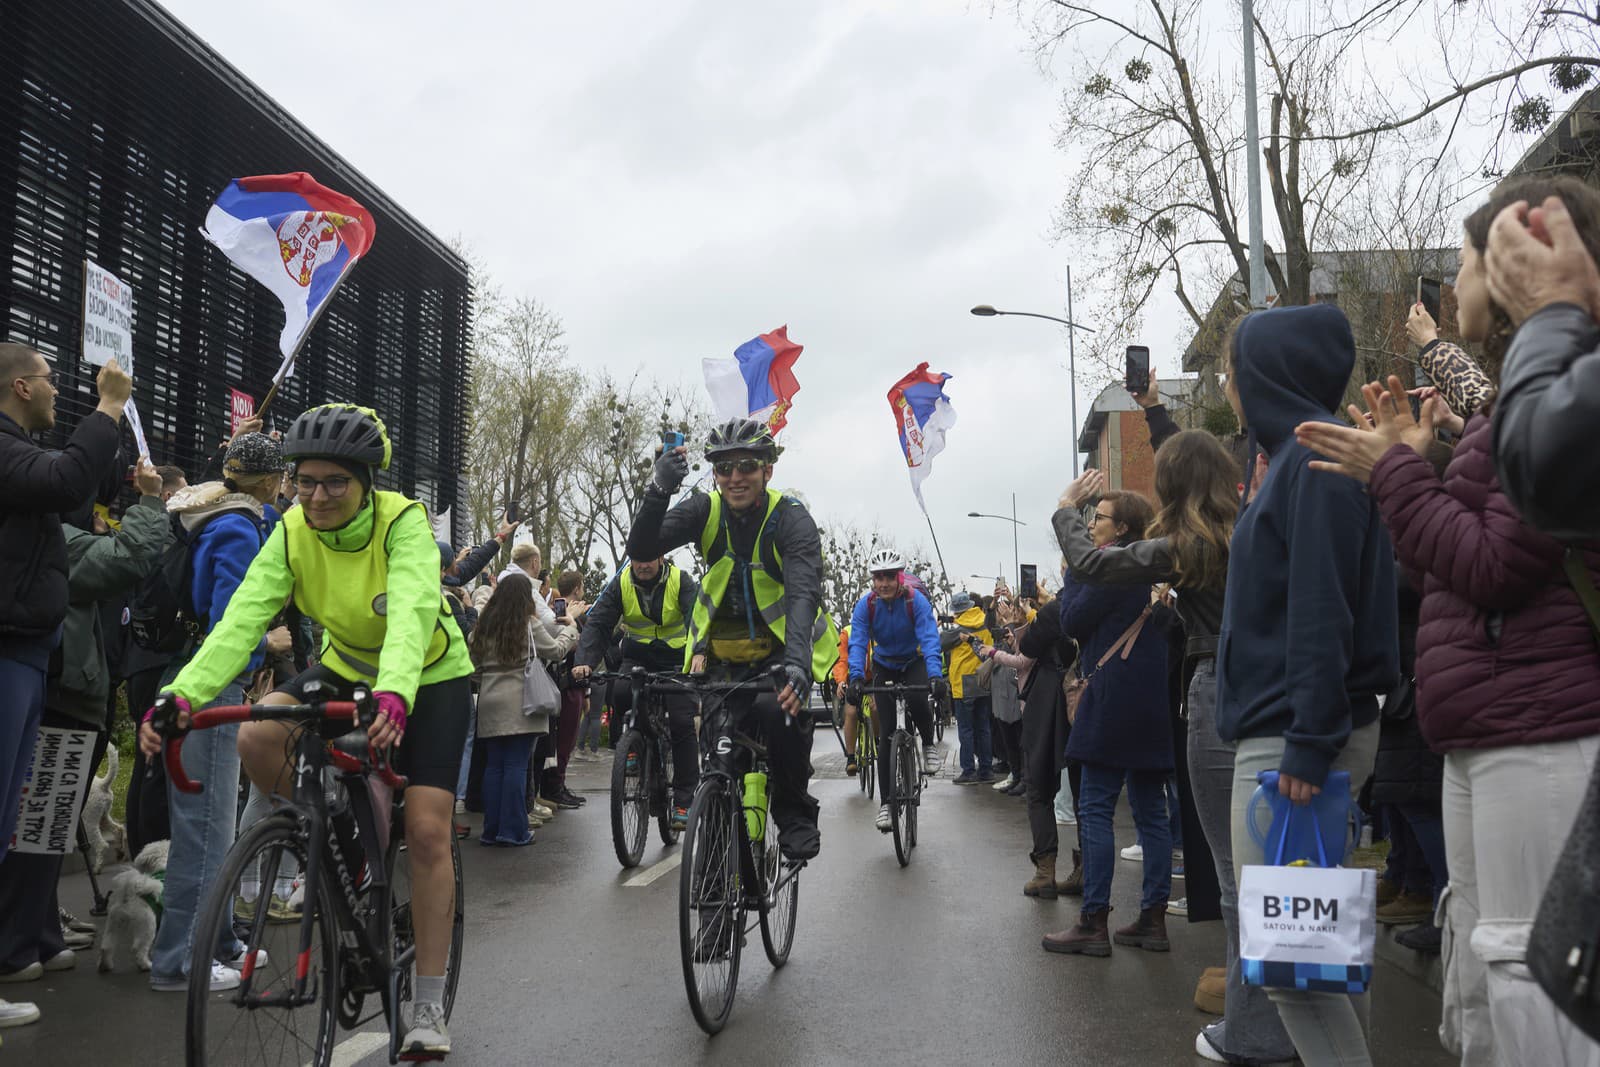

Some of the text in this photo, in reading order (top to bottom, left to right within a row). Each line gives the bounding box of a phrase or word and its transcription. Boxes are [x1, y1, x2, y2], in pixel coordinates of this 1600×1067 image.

[233, 396, 253, 417] NOVI
[68, 733, 86, 745] И
[40, 733, 63, 768] ИМАМО
[64, 751, 82, 770] МИ
[59, 772, 80, 786] СА
[28, 799, 48, 813] ЗА
[22, 815, 45, 845] ТРКУ
[1263, 922, 1296, 931] SATOVI
[1308, 925, 1337, 934] NAKIT
